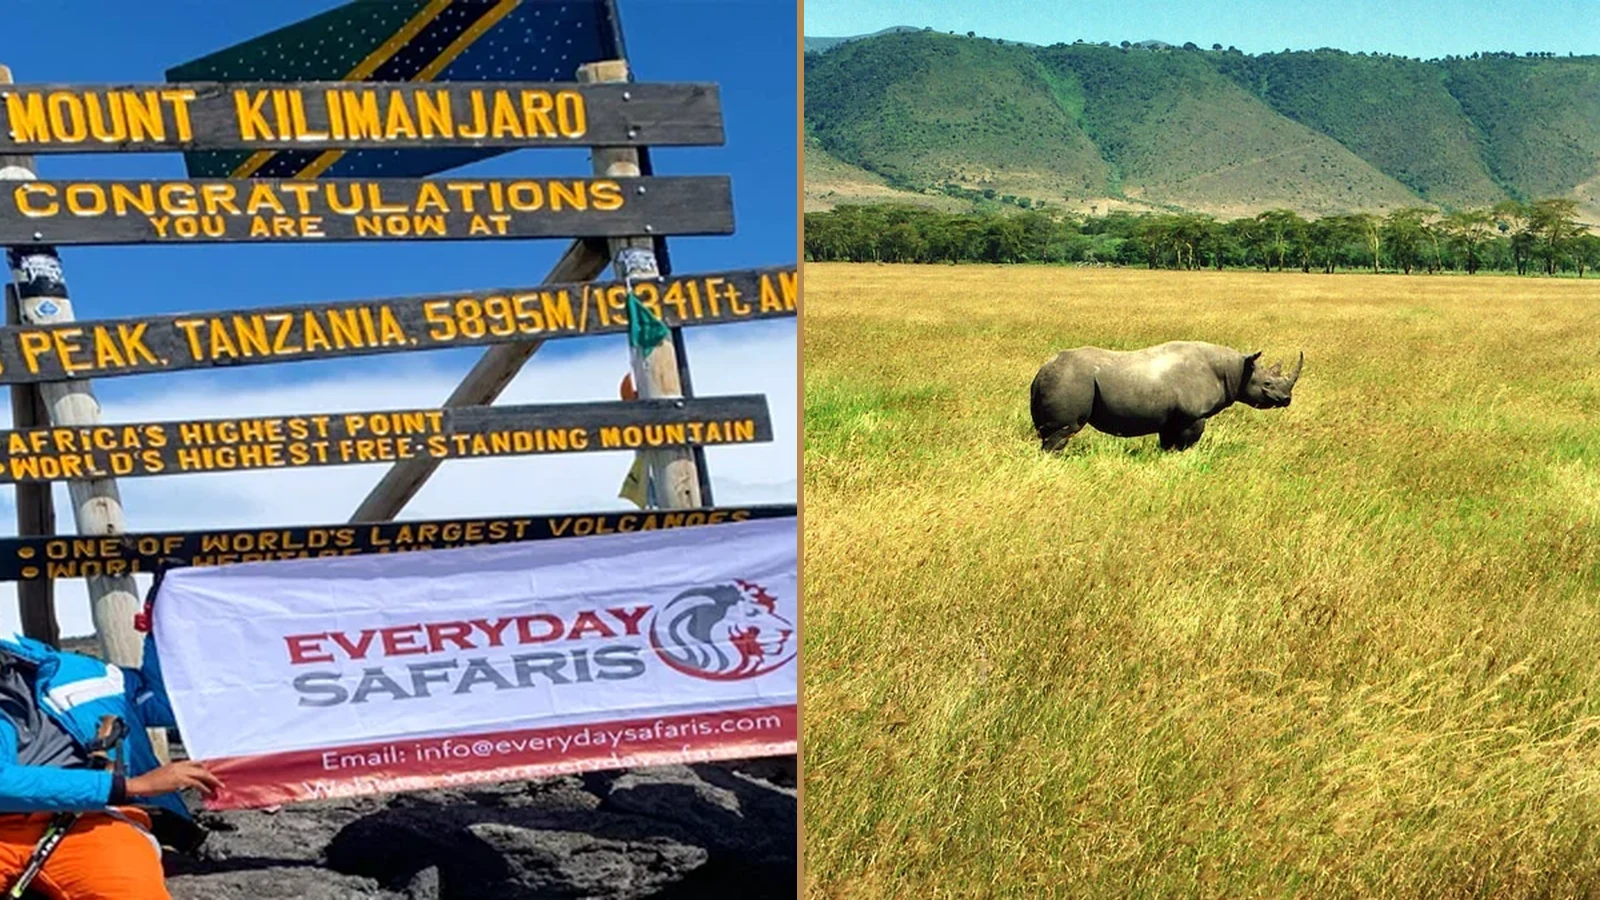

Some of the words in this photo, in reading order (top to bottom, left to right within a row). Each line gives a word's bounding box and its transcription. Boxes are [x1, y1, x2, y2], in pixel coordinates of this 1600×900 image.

[6, 89, 196, 143] MOUNT
[233, 89, 587, 142] KILIMANJARO
[13, 181, 624, 218] CONGRATULATIONS
[149, 215, 226, 238] YOU
[249, 215, 325, 237] ARE
[354, 215, 446, 236] NOW
[469, 214, 511, 235] AT
[19, 321, 169, 374] PEAK,
[175, 304, 418, 361] TANZANIA,
[8, 424, 167, 455] AFRICA'S
[181, 415, 330, 445] HIGHEST
[344, 410, 443, 437] POINT
[177, 441, 330, 471] HIGHEST
[600, 420, 755, 448] MOUNTAIN
[46, 538, 121, 559] ONE
[138, 536, 185, 555] OF
[202, 528, 354, 551] WORLD'S
[370, 520, 531, 546] LARGEST
[283, 605, 654, 665] EVERYDAY
[293, 645, 646, 707] SAFARIS
[322, 746, 406, 770] Email:
[416, 715, 781, 761] info@everydaysafaris.com
